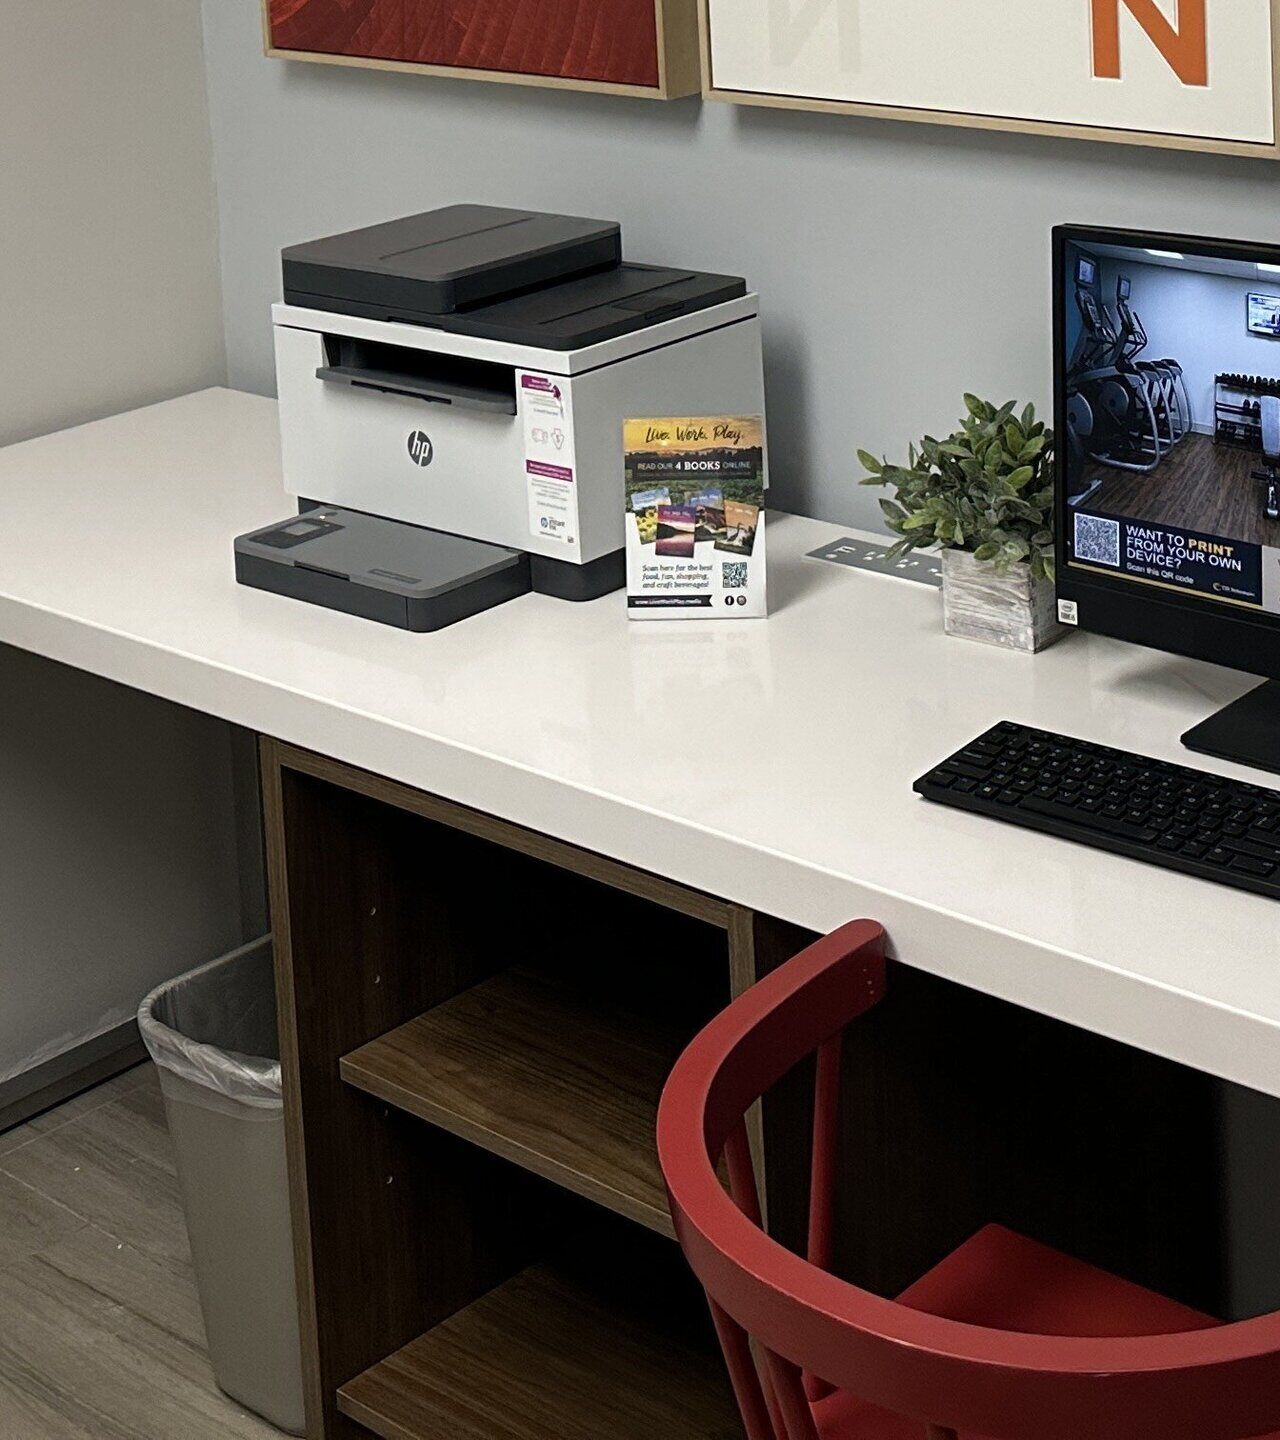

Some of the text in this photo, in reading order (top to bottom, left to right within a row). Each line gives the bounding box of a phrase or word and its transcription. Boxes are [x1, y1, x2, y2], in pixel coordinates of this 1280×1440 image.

[411, 431, 432, 466] hp
[674, 461, 682, 470] 4
[684, 461, 720, 470] BOOKS
[1125, 524, 1233, 558] WANT TO PRINT
[1127, 535, 1241, 571] FROM YOUR OWN
[1127, 546, 1181, 570] DEVICE?
[1127, 561, 1193, 585] Scan this QR code
